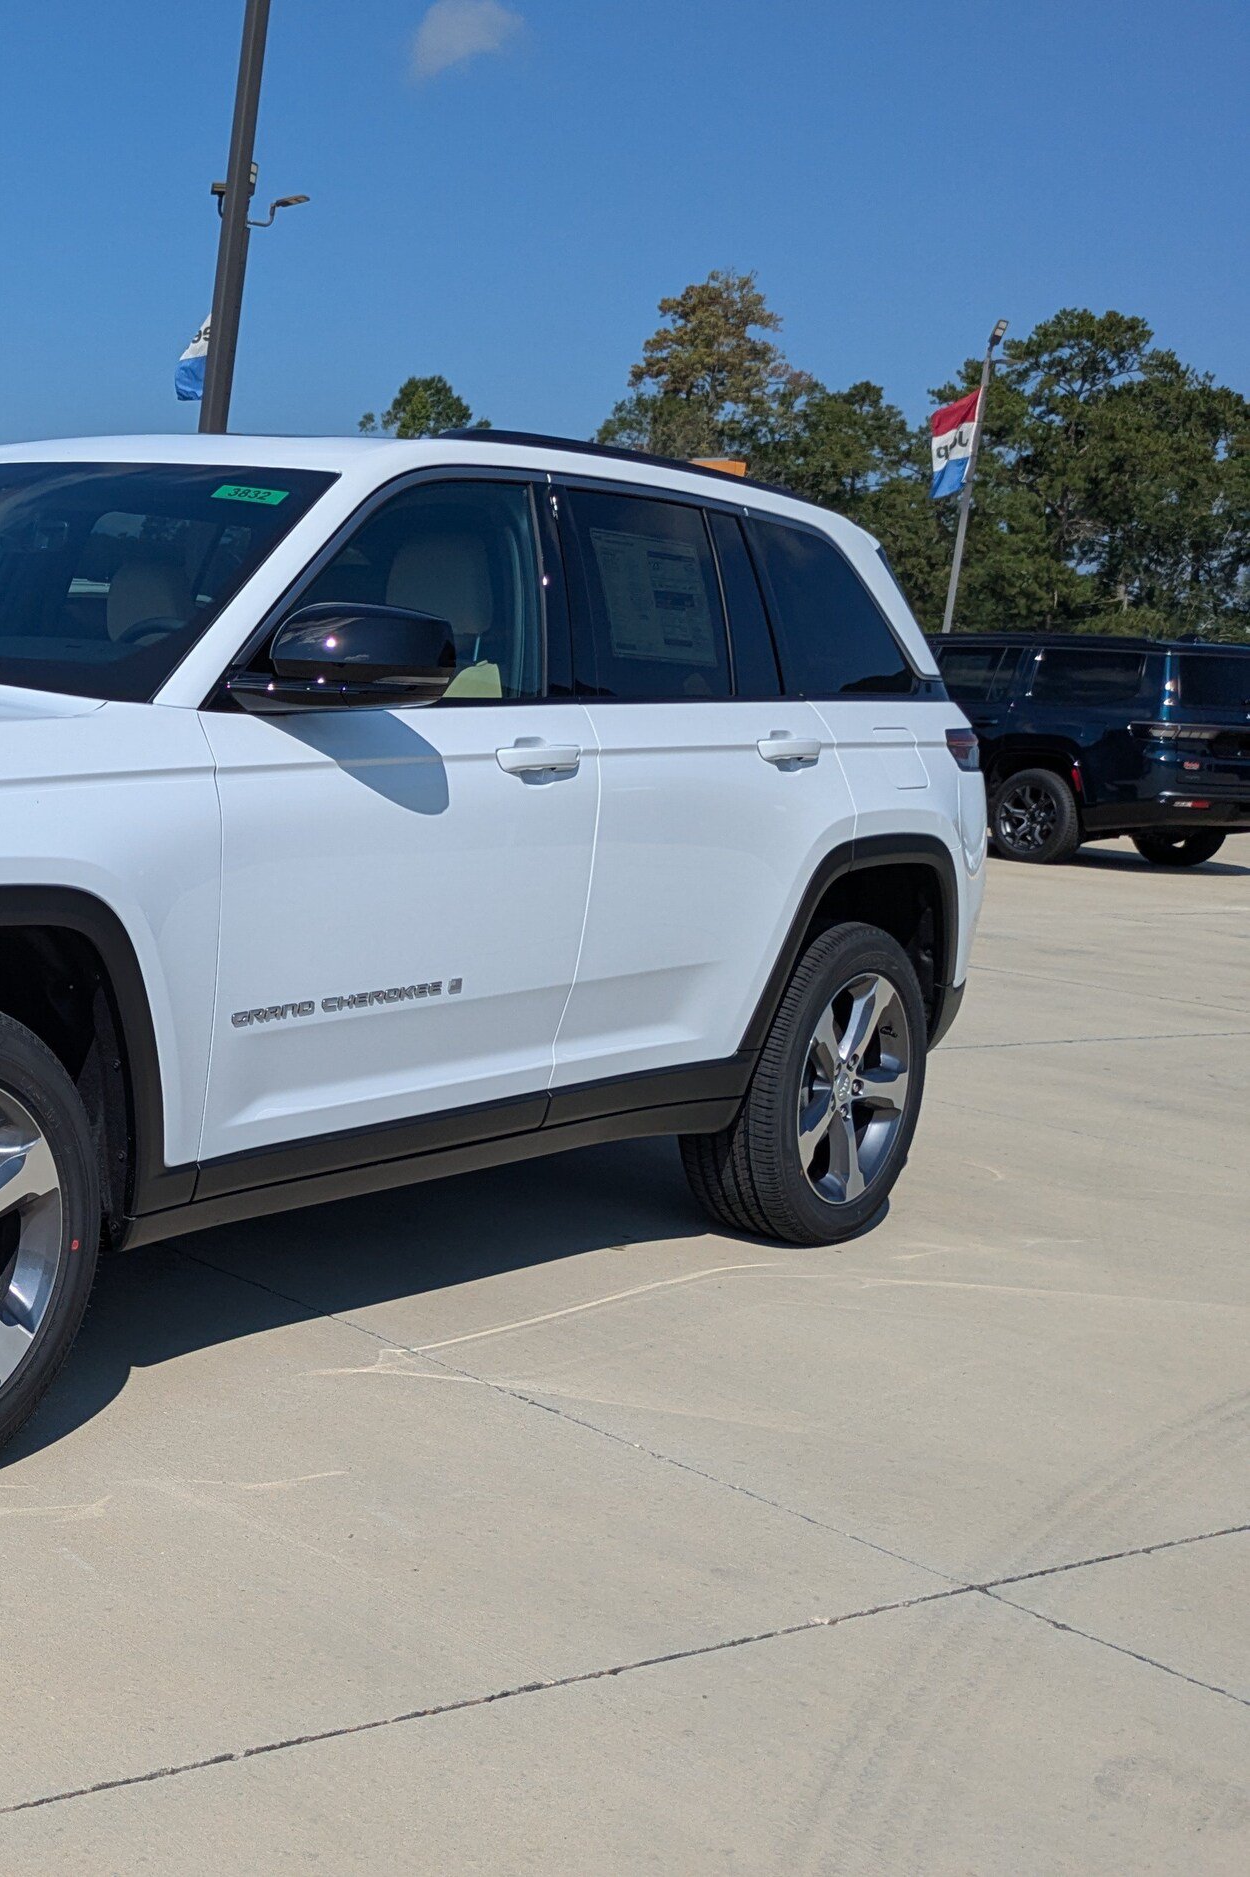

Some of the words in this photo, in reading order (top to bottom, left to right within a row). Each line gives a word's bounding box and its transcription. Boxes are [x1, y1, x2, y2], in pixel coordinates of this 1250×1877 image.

[228, 488, 272, 500] 3832
[231, 1000, 316, 1028] GRAND
[321, 980, 443, 1013] CHEROKEE
